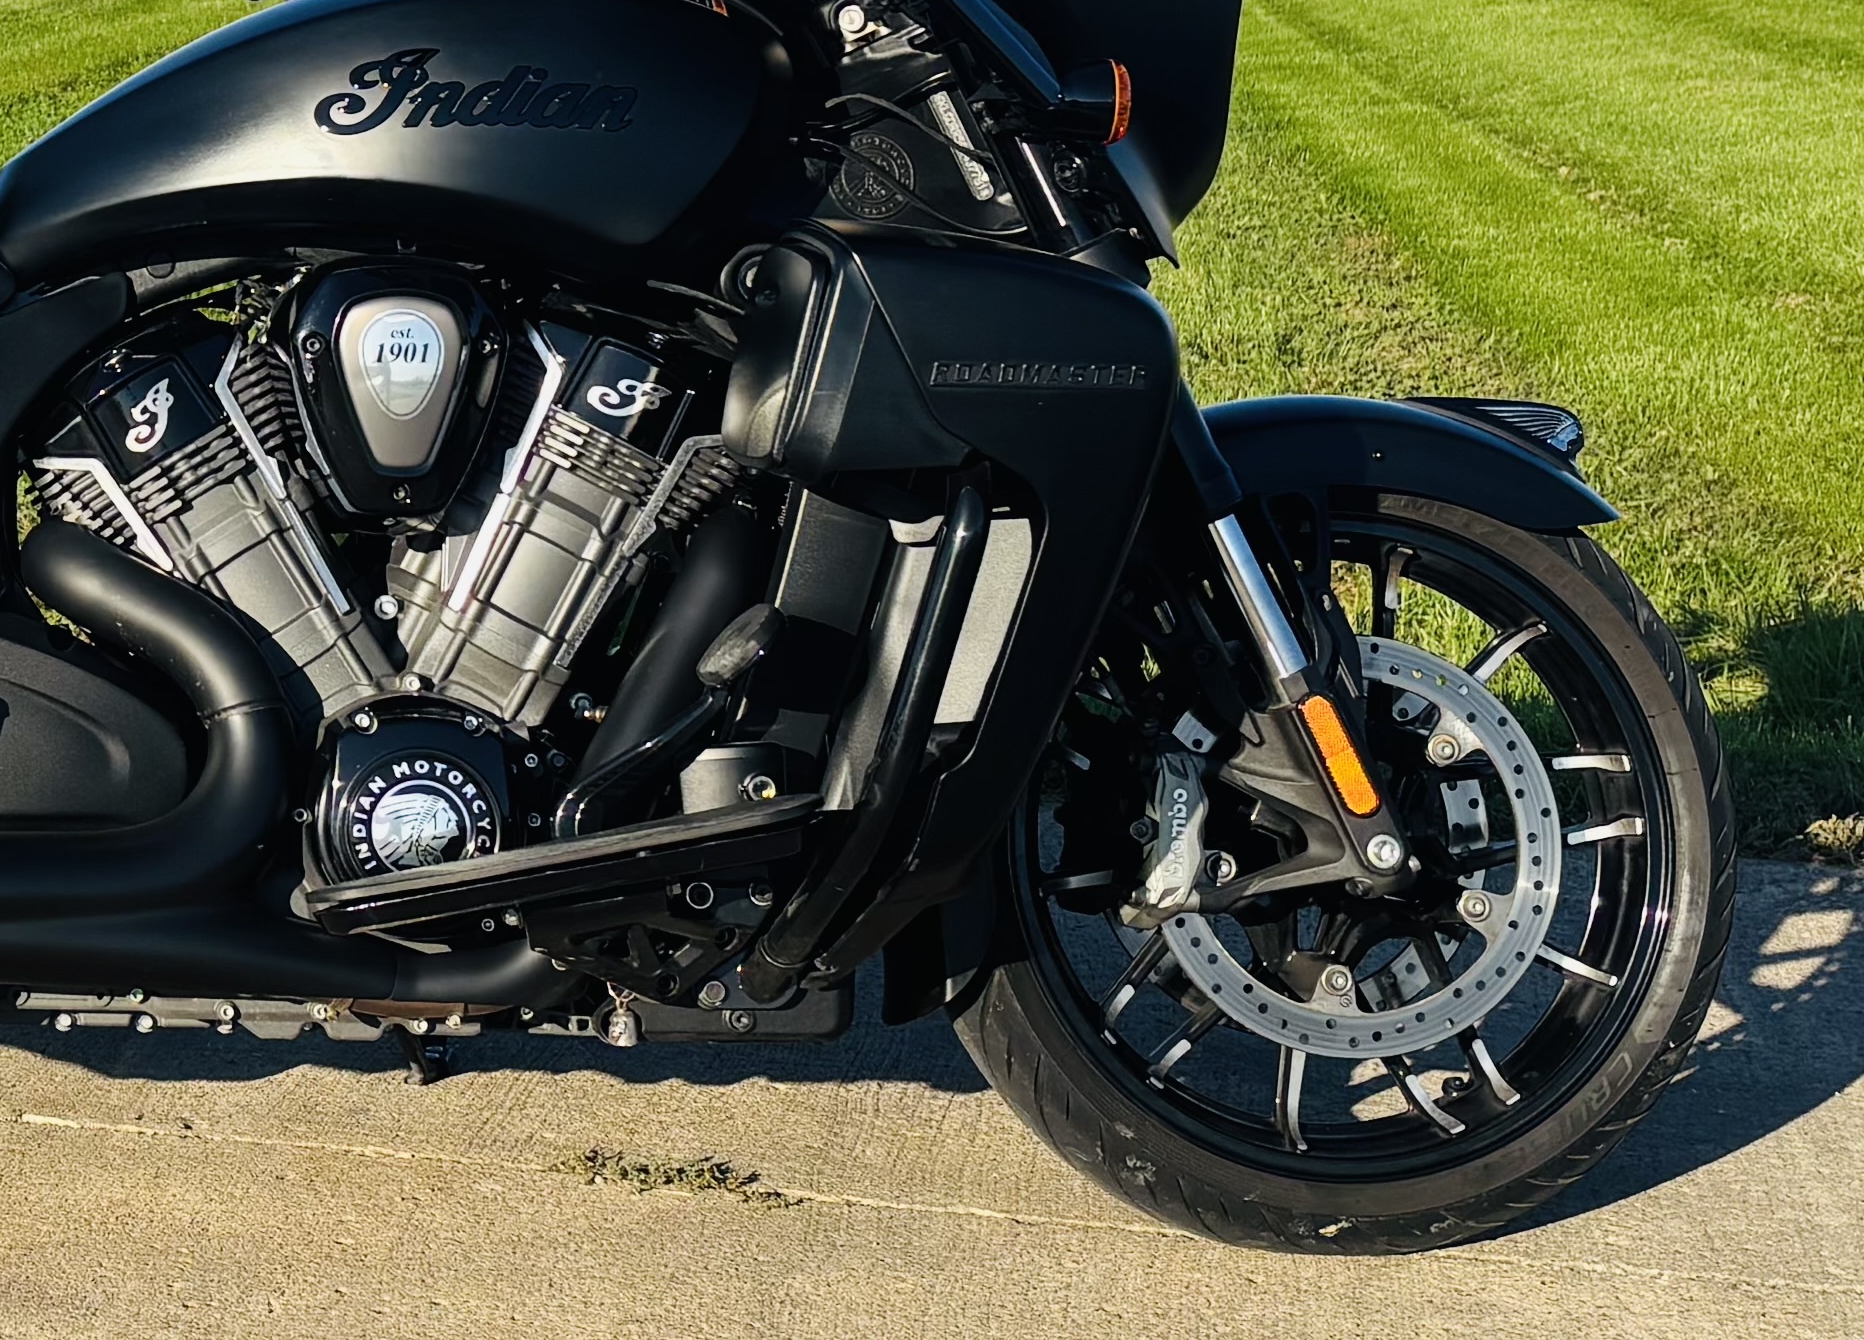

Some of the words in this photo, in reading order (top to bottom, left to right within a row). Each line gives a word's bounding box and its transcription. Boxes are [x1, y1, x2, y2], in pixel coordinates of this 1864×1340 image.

[314, 47, 638, 136] Indian
[390, 327, 415, 339] est.
[372, 342, 430, 363] 1901
[930, 362, 1146, 387] ROADMASTER
[352, 775, 387, 870] INDIAN
[392, 760, 492, 857] MOTORCYC
